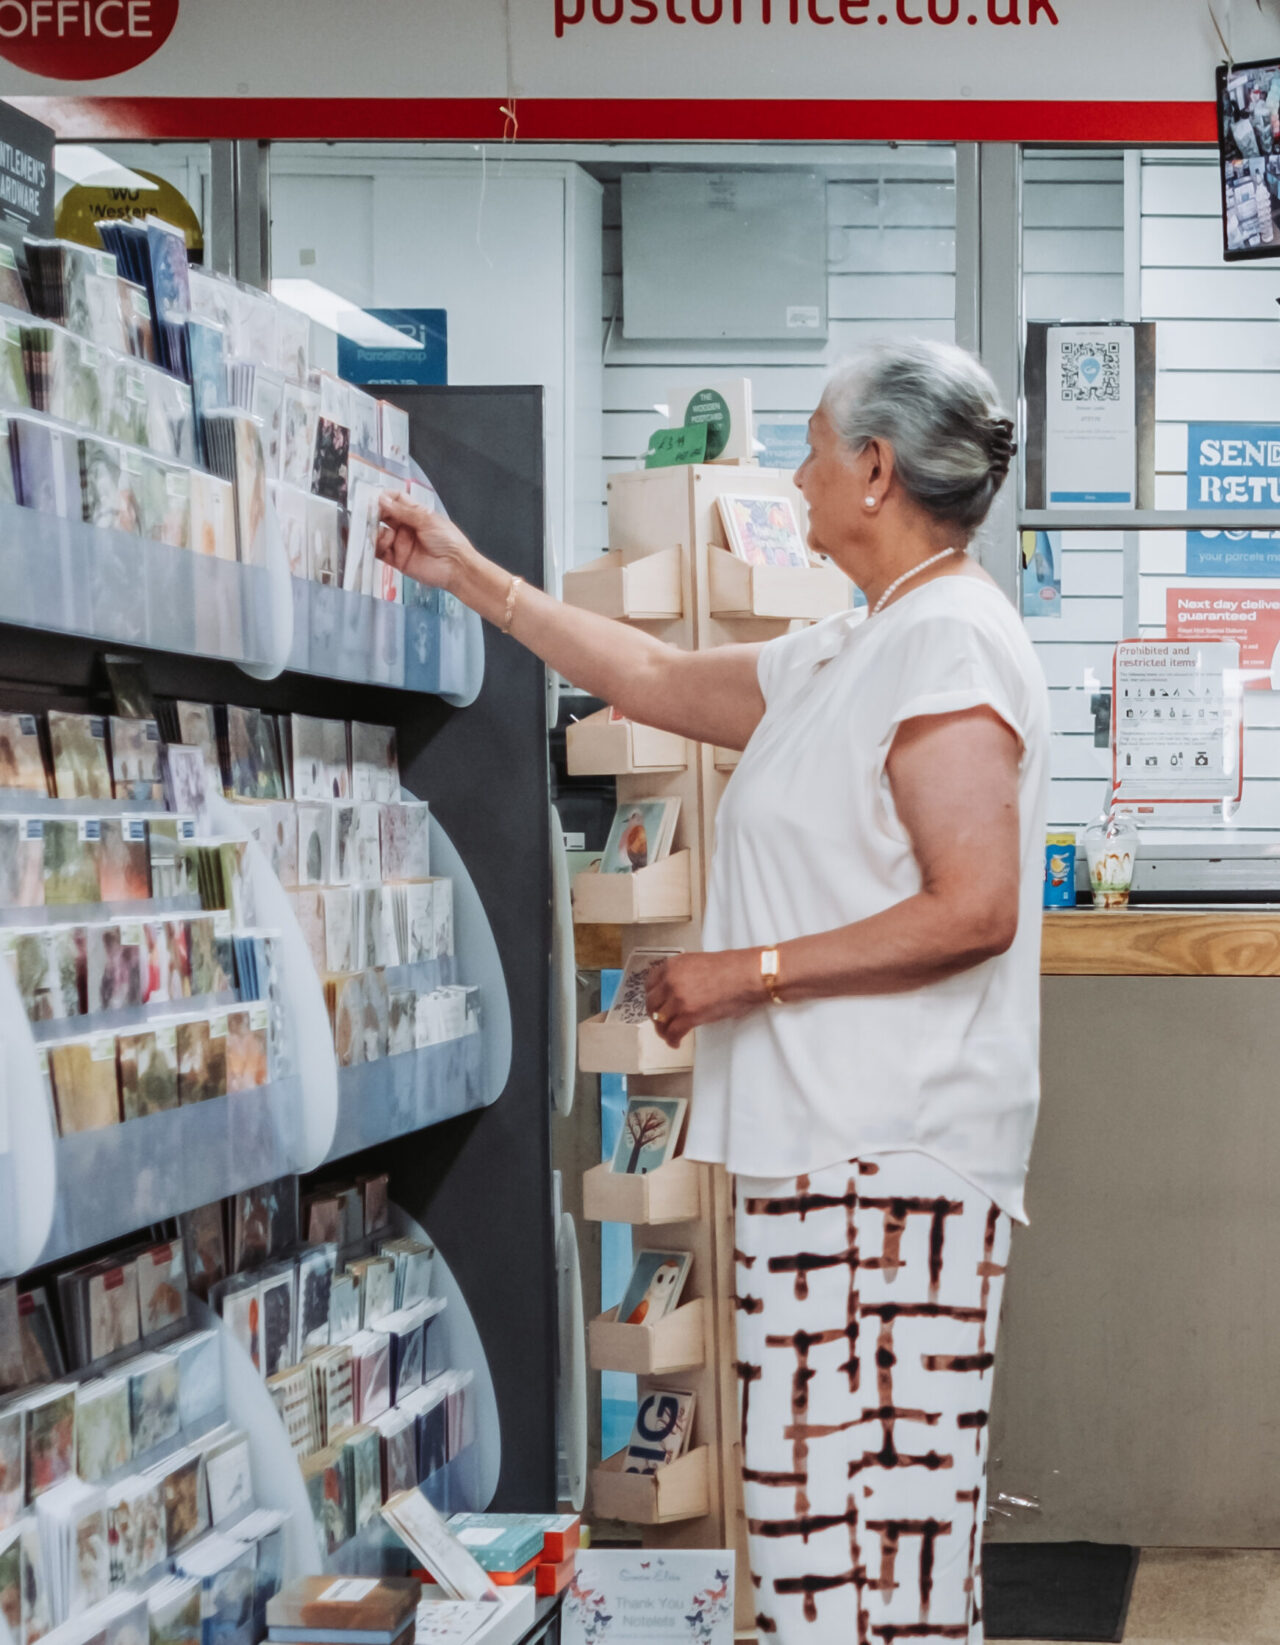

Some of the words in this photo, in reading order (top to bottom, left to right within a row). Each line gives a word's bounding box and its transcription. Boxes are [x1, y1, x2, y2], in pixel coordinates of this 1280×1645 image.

[0, 0, 153, 38] OFFICE
[89, 204, 159, 219] Western
[1199, 552, 1222, 562] your
[1225, 551, 1265, 563] parcels
[1177, 599, 1211, 609] Next
[1213, 599, 1238, 611] day
[1177, 611, 1257, 622] guaranteed
[1119, 646, 1169, 655] Prohibited
[1172, 646, 1190, 655] and
[1119, 659, 1167, 667] restricted
[1170, 659, 1196, 667] items
